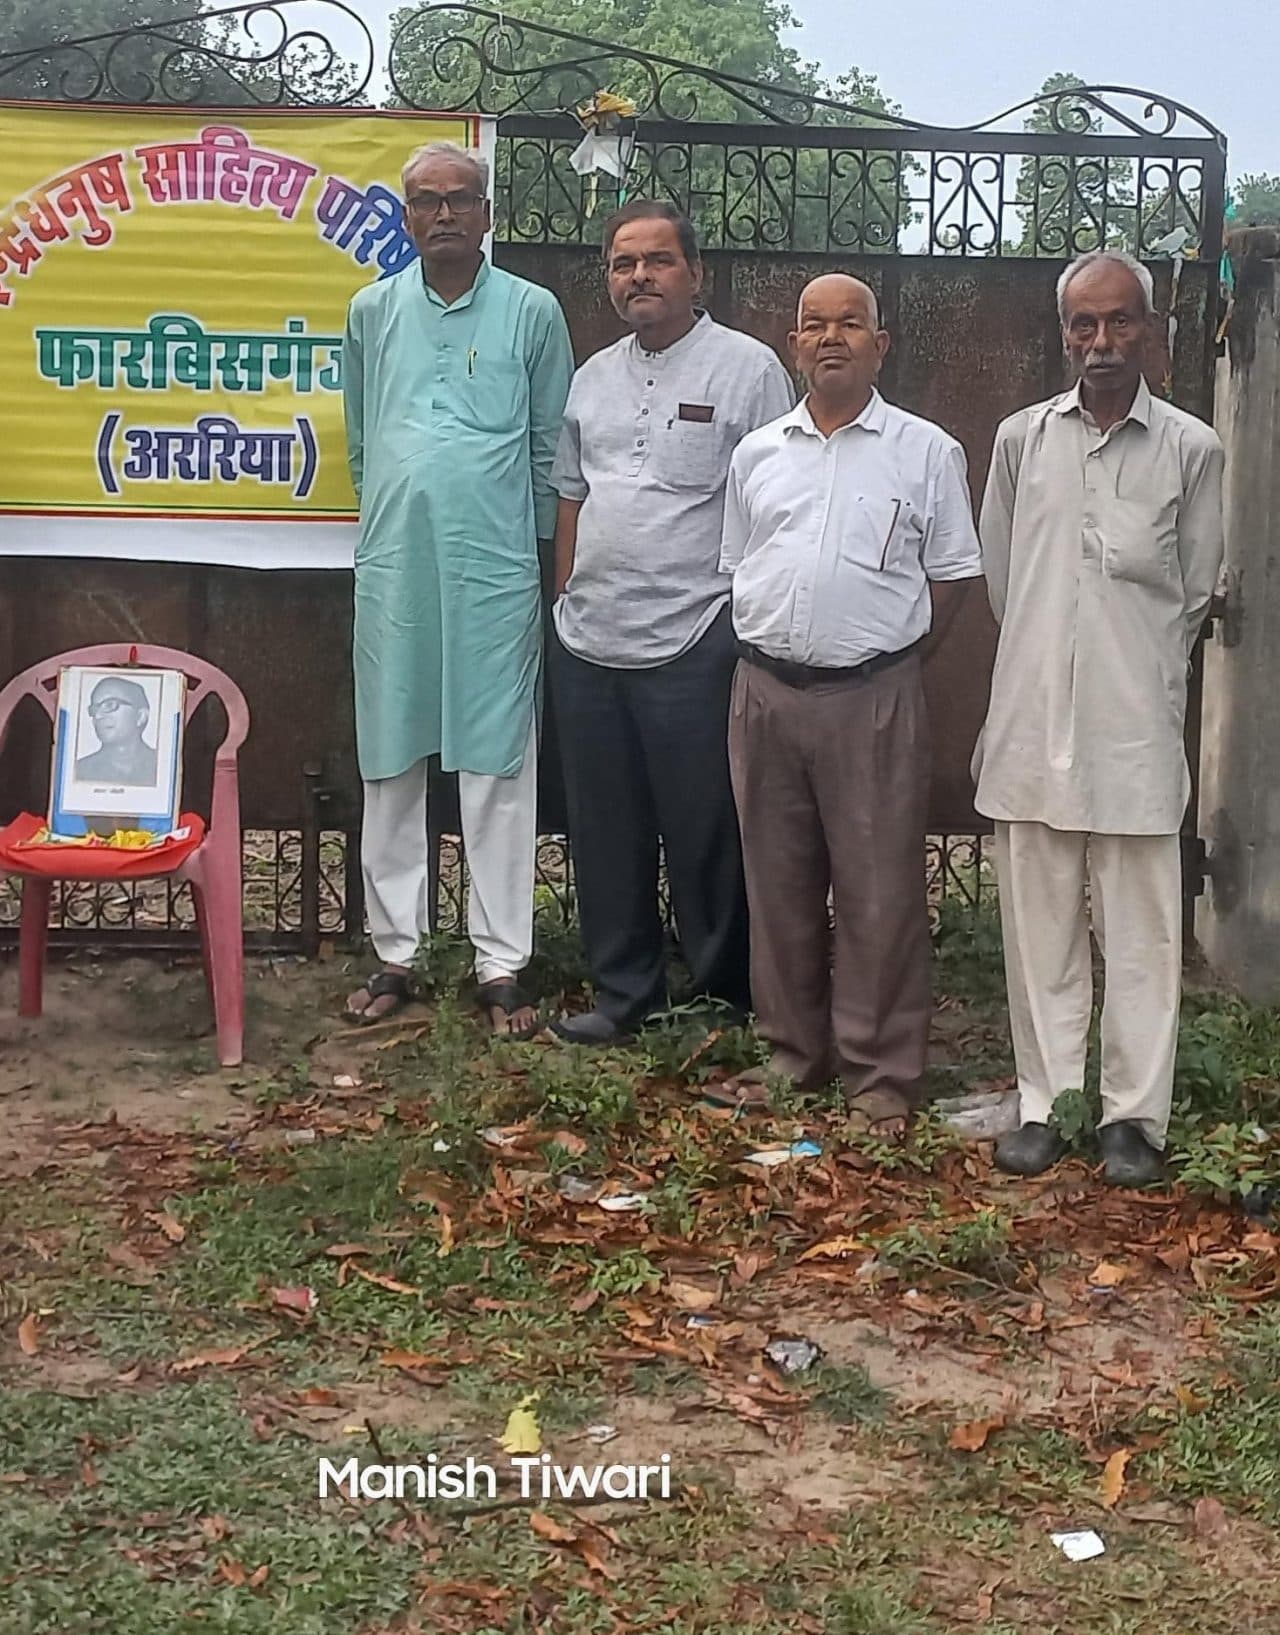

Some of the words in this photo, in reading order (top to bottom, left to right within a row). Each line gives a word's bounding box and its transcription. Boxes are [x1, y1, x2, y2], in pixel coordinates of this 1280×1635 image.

[135, 127, 317, 218] साहित्य
[317, 176, 420, 281] परिष
[97, 414, 317, 497] (अररिया)
